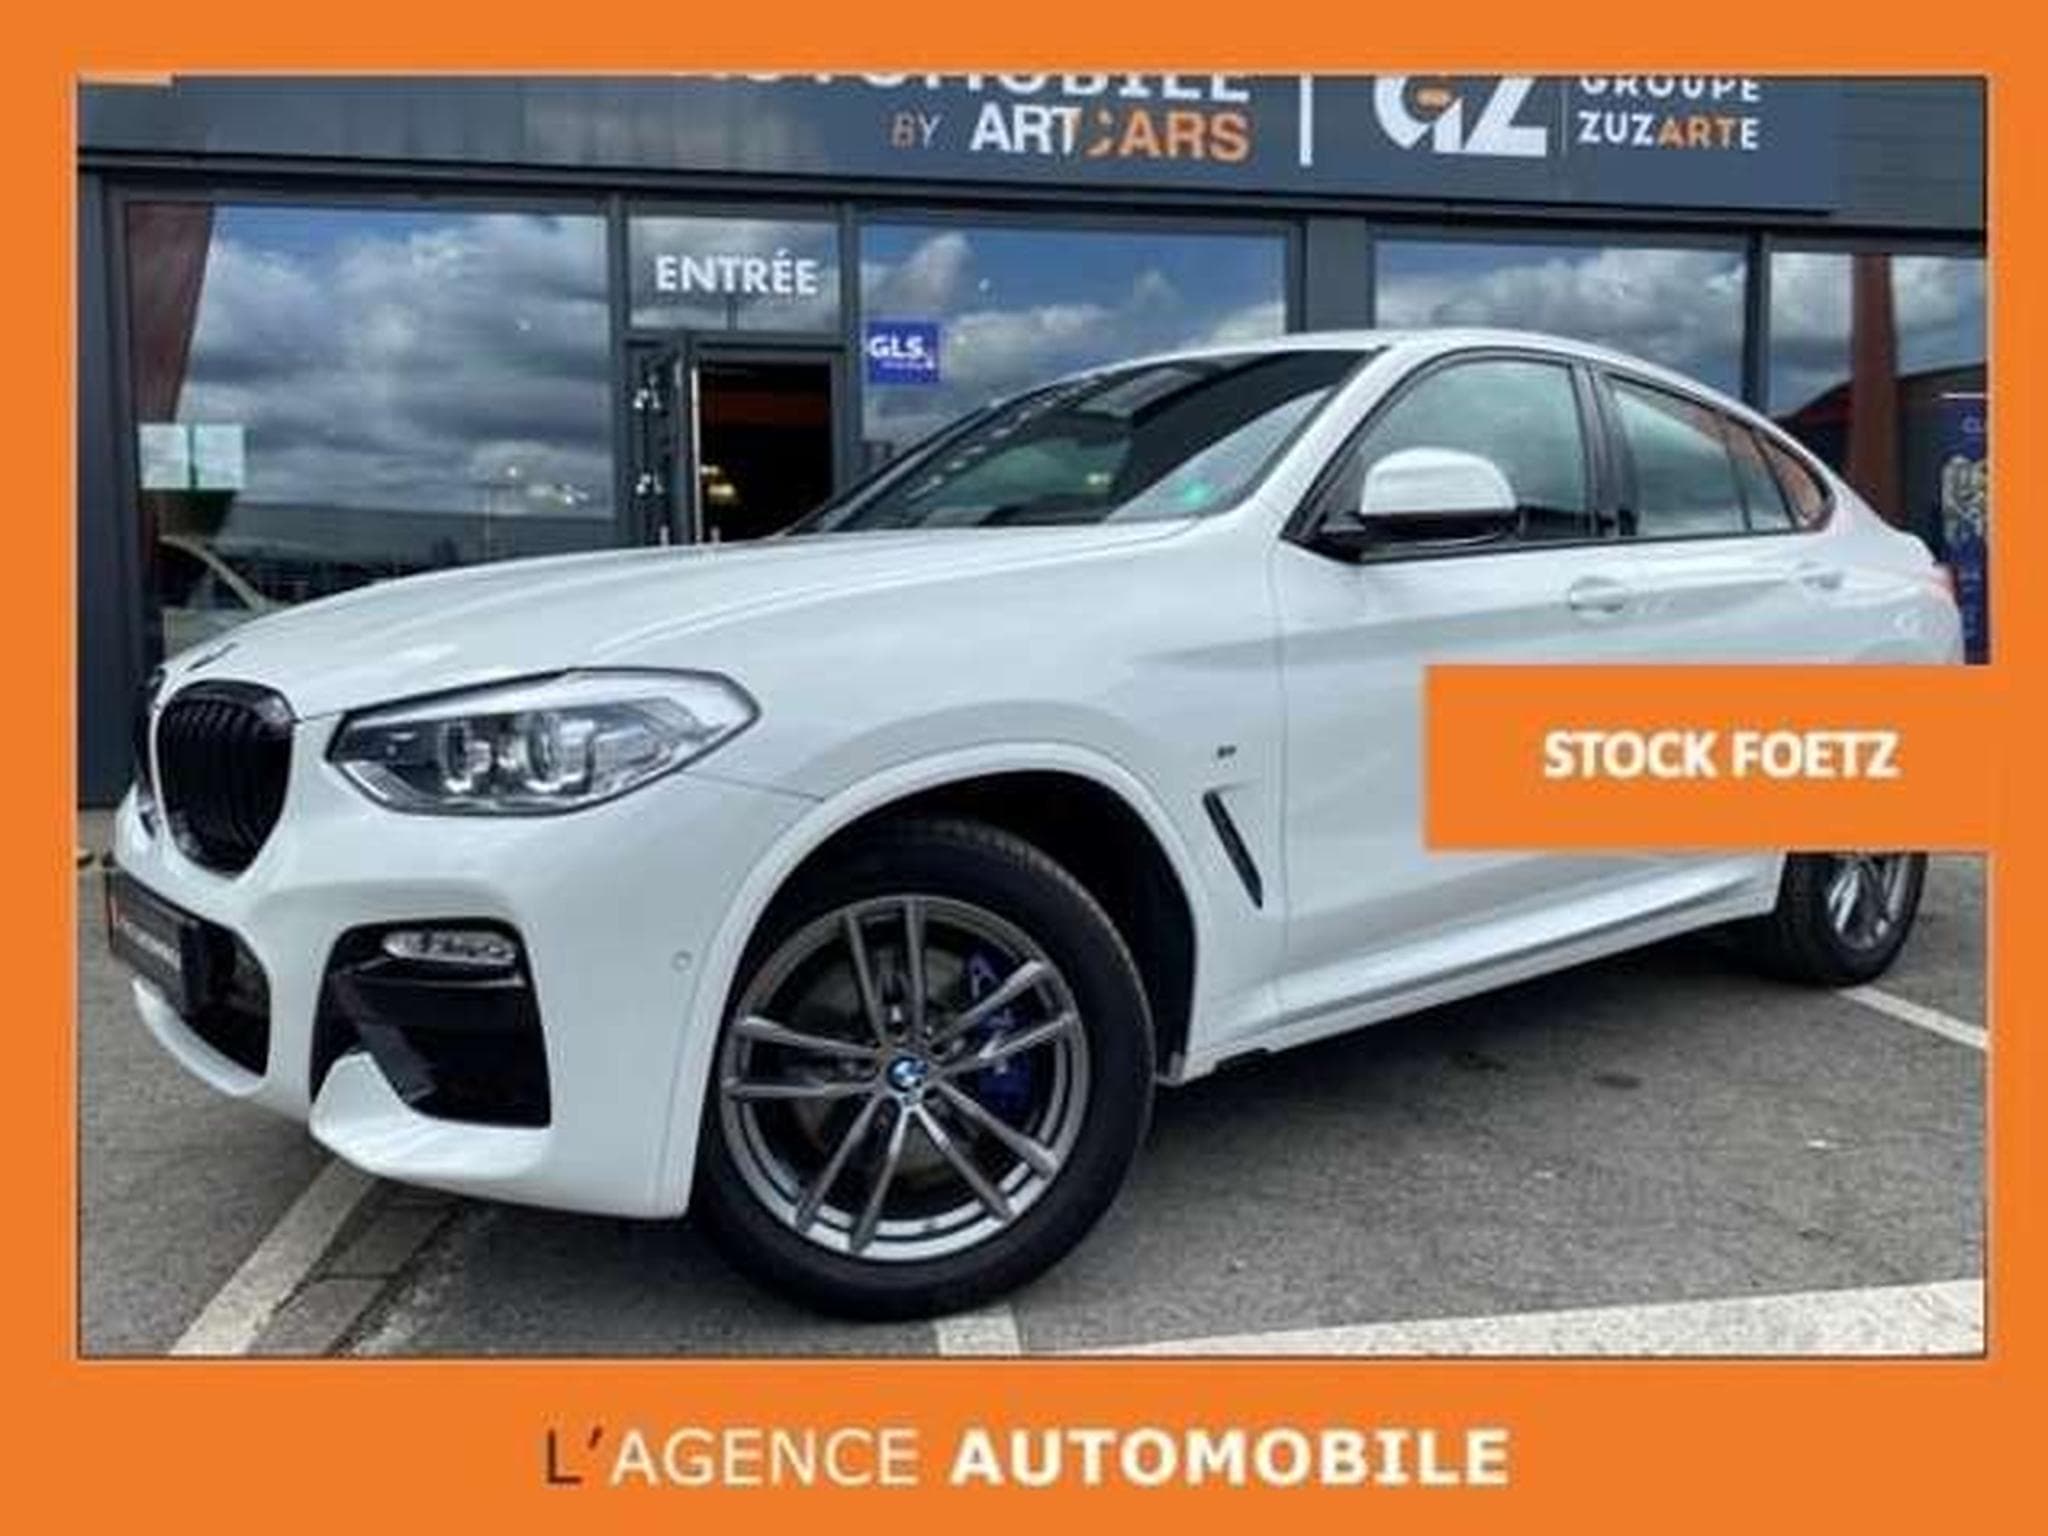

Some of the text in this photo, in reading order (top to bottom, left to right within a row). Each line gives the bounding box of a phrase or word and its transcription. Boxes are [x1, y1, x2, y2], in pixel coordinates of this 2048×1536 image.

[891, 109, 942, 149] BY
[1577, 110, 1761, 151] ZUZARTE
[655, 248, 819, 295] ENTRÉE
